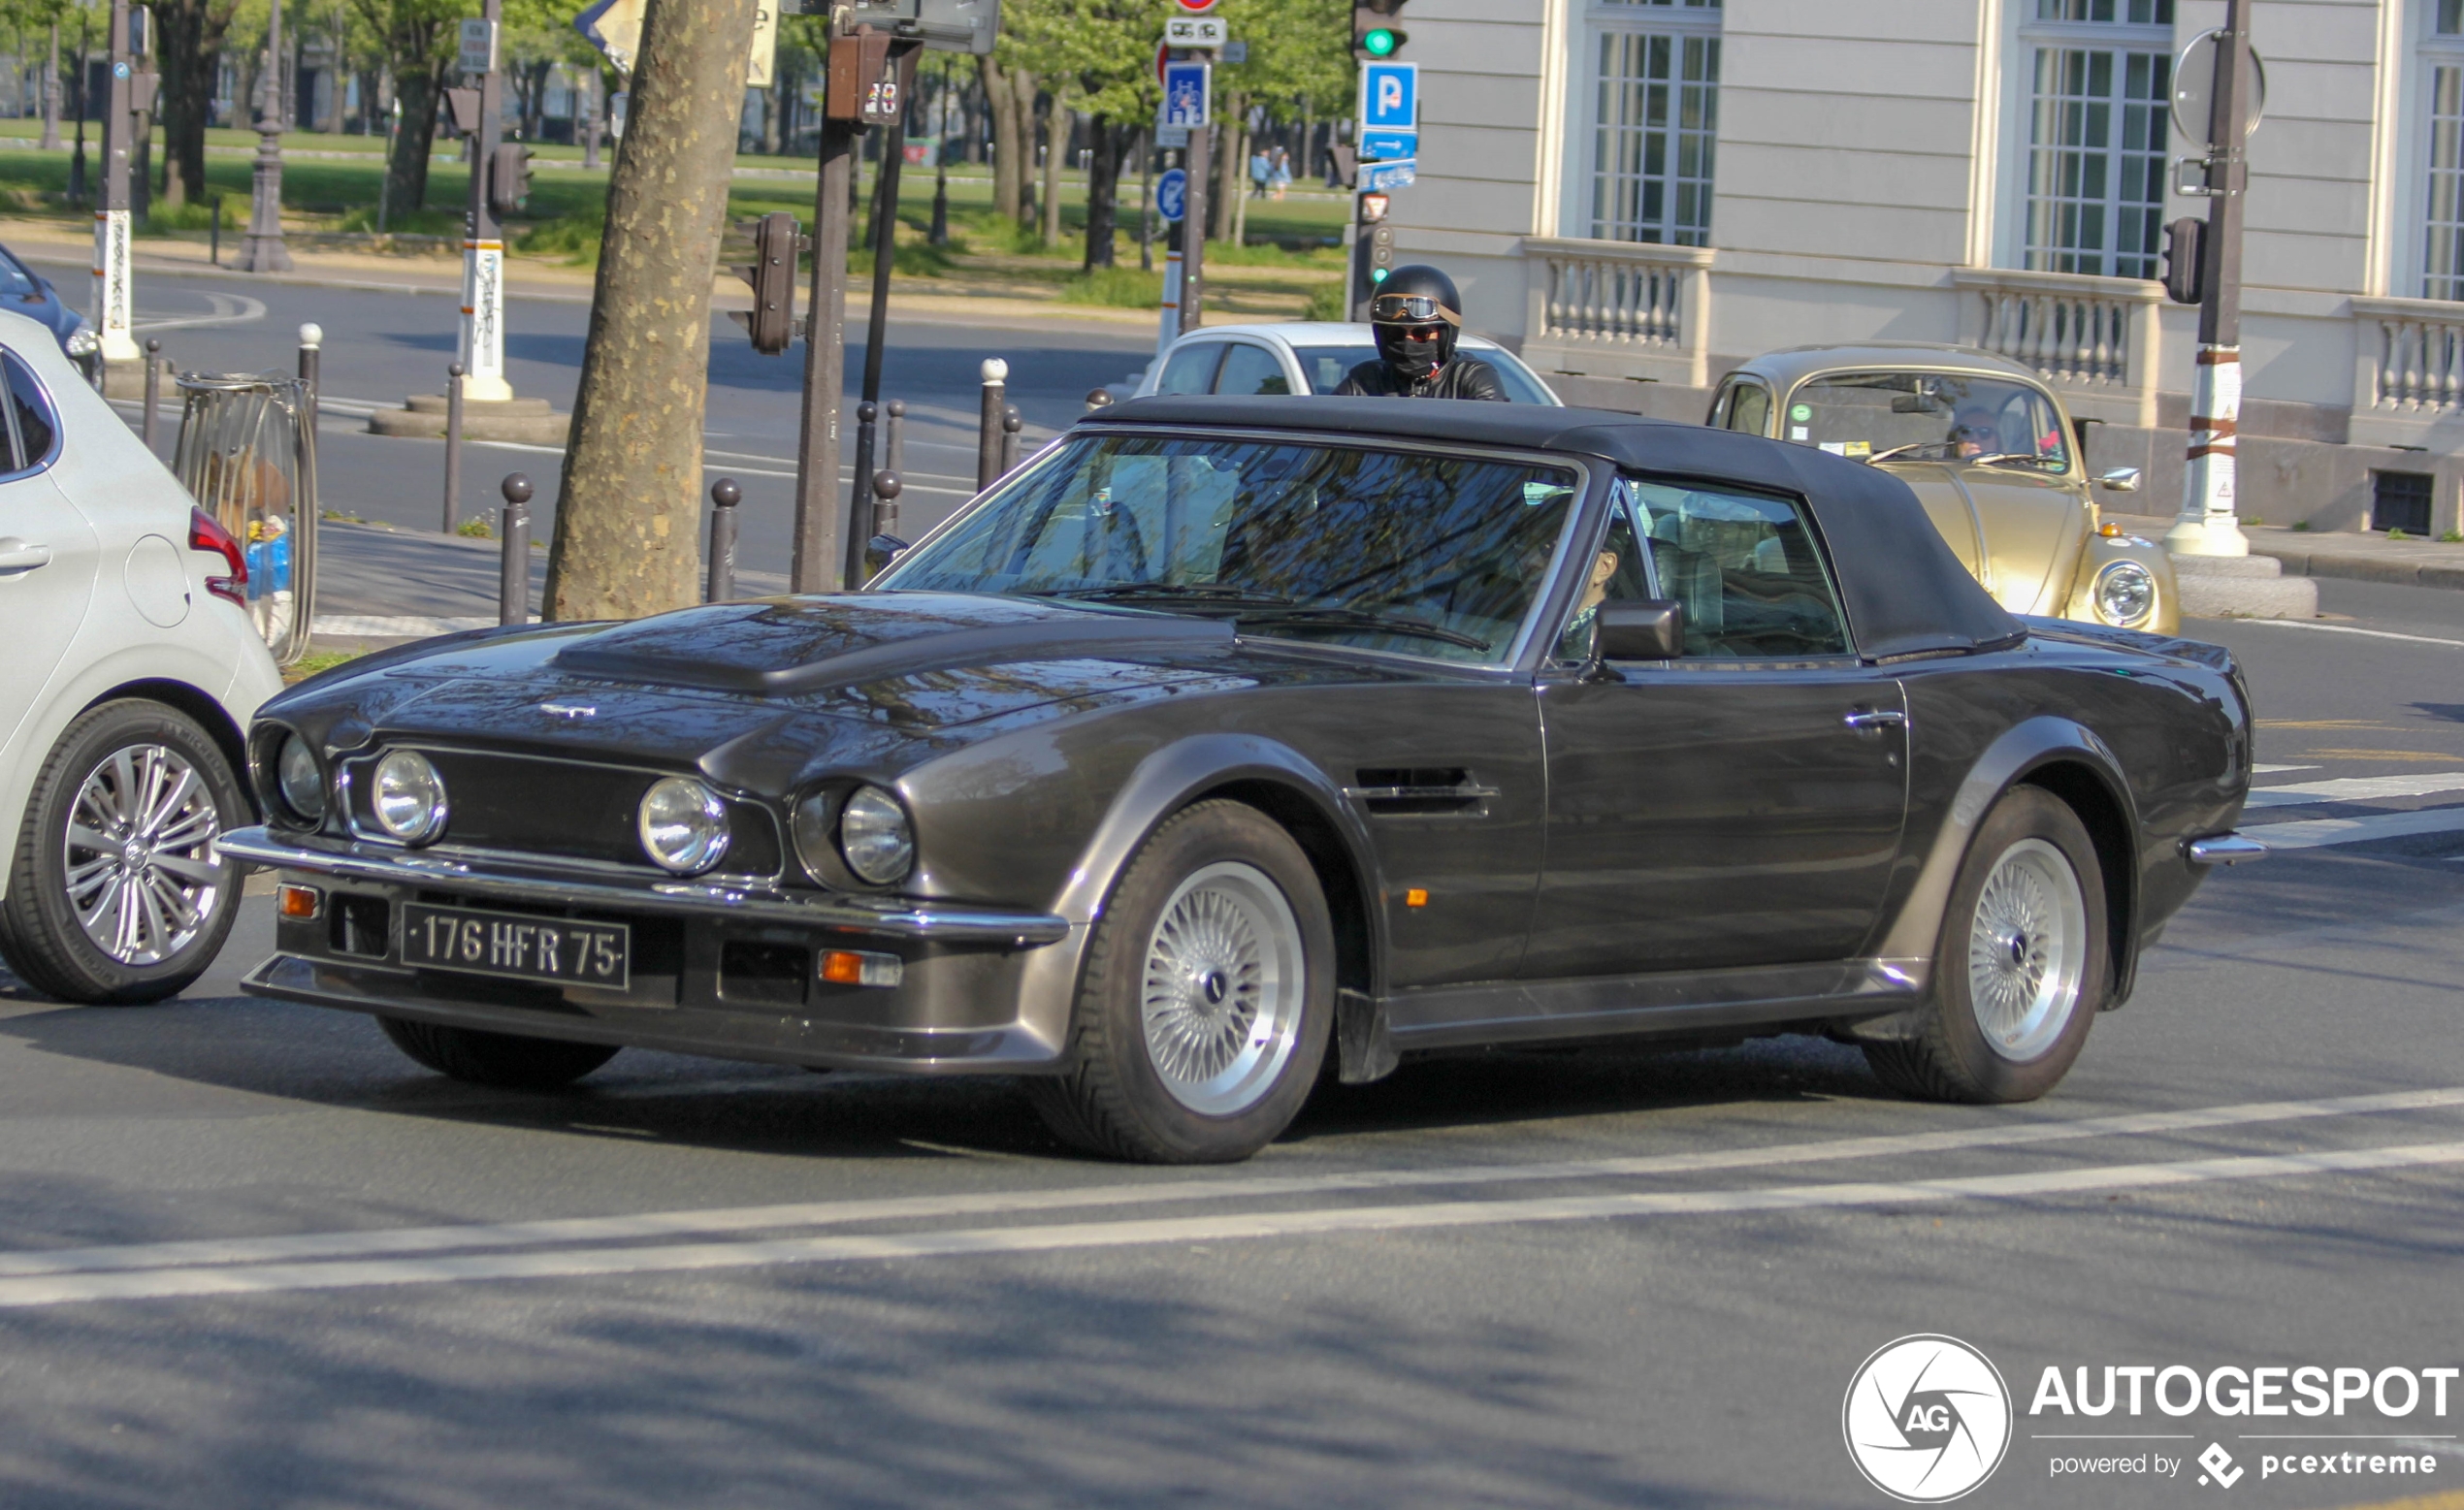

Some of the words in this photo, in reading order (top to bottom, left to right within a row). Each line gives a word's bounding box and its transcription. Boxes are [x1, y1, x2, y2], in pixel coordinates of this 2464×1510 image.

[1378, 75, 1403, 117] P
[424, 915, 482, 962] 176
[490, 921, 560, 973] HFR
[569, 930, 616, 977] 75
